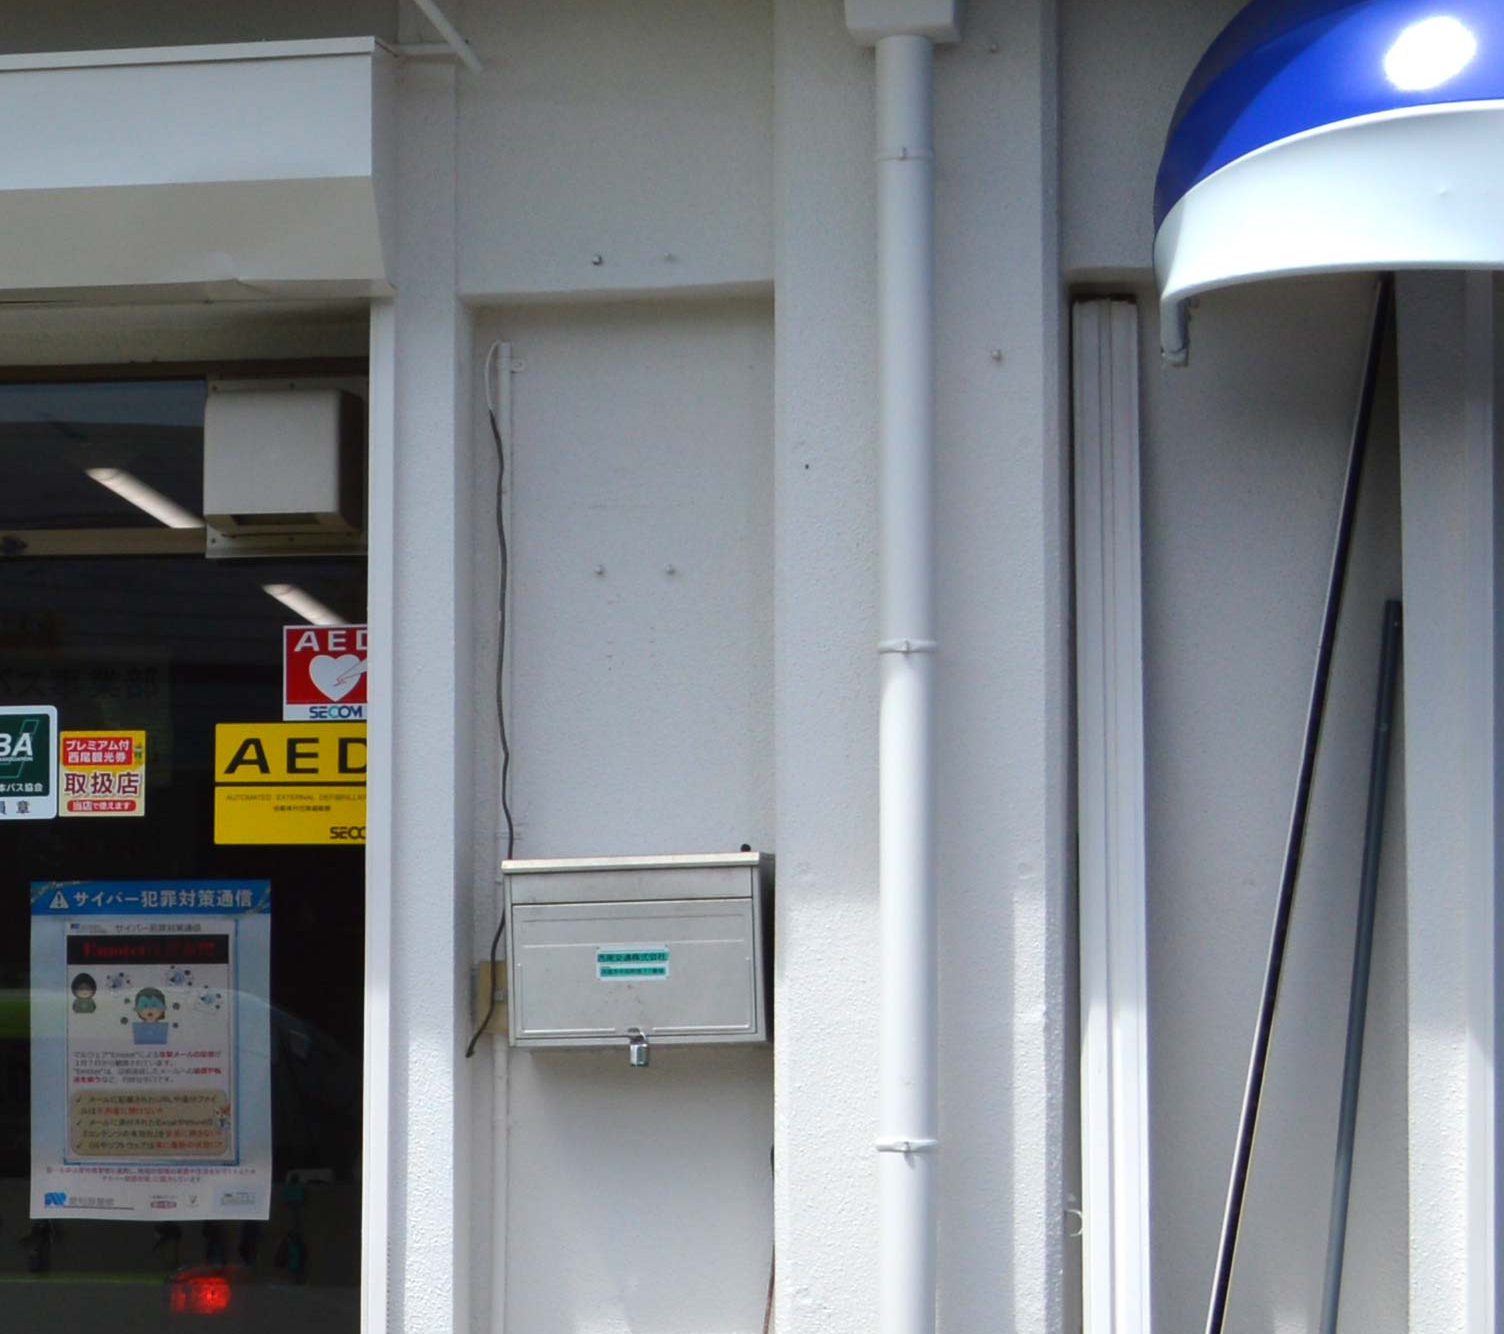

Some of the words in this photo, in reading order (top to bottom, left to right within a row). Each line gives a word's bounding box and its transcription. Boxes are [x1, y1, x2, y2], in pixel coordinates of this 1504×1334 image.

[309, 705, 363, 719] SECOM
[65, 740, 130, 751] プレミアム付
[224, 738, 367, 774] AED
[64, 772, 139, 796] 取扱店
[74, 890, 253, 908] サイバー犯罪対策通信
